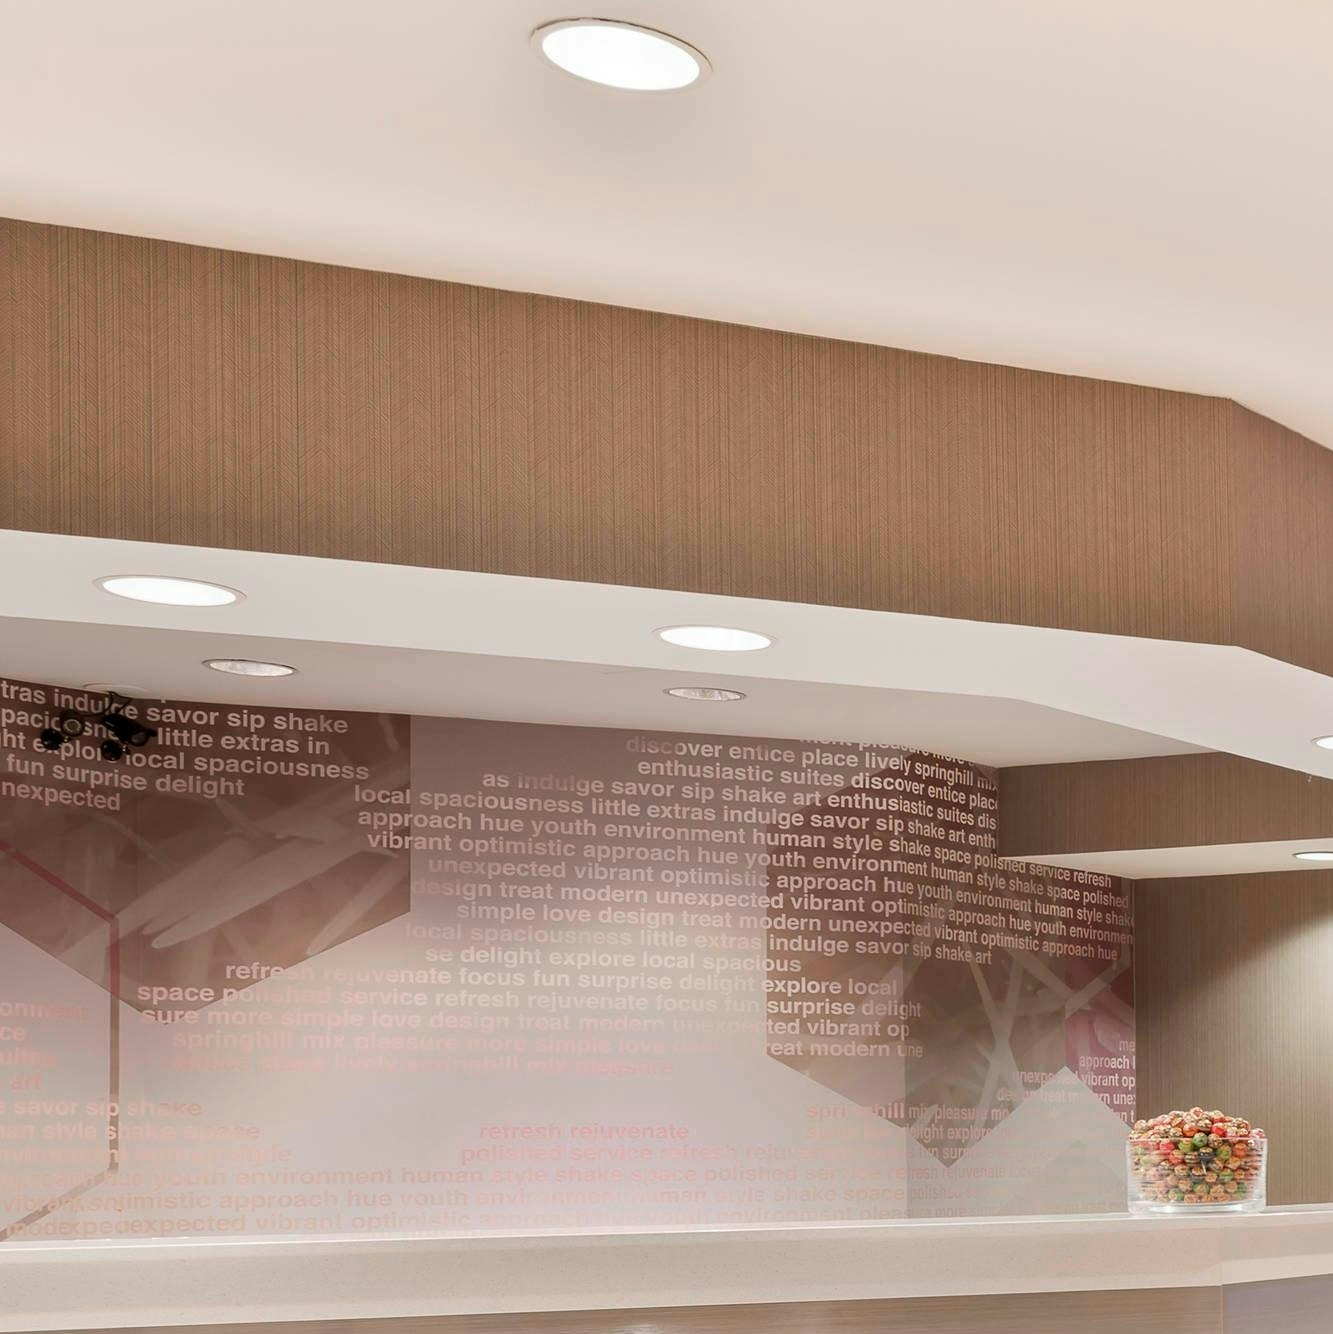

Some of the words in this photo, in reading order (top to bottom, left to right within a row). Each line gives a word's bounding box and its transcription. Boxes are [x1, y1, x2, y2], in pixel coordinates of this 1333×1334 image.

[146, 706, 218, 723] savor
[227, 708, 264, 731] sip
[273, 711, 348, 732] shake
[157, 724, 212, 747] little
[220, 734, 299, 752] extras
[308, 737, 329, 754] in
[6, 756, 44, 776] fun
[52, 766, 147, 789] surprise
[155, 773, 245, 798] delight
[126, 746, 184, 768] local
[194, 756, 368, 780] spaciousness
[626, 735, 721, 757] discover
[729, 744, 794, 762] entice
[801, 747, 858, 768] place
[865, 751, 910, 777] lively
[914, 761, 973, 785] springhill
[637, 759, 773, 782] enthusiastic
[780, 767, 844, 786] suites
[852, 770, 924, 794] discover
[928, 783, 965, 803] entice
[482, 774, 509, 788] as
[518, 772, 604, 797] indulge
[611, 781, 673, 796] savor
[680, 781, 713, 803] sip
[721, 783, 786, 803] shake
[792, 789, 820, 805] art
[827, 790, 933, 817] enthusiastic
[936, 804, 974, 825] suites
[354, 784, 409, 804] local
[420, 791, 583, 813] spaciousness
[591, 796, 640, 816] little
[646, 802, 715, 820] extras
[723, 804, 804, 828] indulge
[810, 813, 868, 830] savor
[875, 815, 903, 838] sip
[908, 818, 945, 839] shake
[948, 826, 965, 842] art
[968, 830, 995, 848] enth
[358, 812, 471, 831] approach
[480, 813, 523, 832] hue
[530, 817, 596, 837] youth
[603, 821, 745, 842] environment
[752, 825, 825, 847] human
[832, 832, 882, 854] style
[888, 834, 931, 855] shake
[934, 843, 971, 862] space
[1029, 861, 1071, 880] service
[1073, 866, 1111, 887] refresh
[367, 832, 451, 851] vibrant
[459, 836, 576, 857] optimistic
[583, 843, 690, 862] approach
[697, 844, 738, 863] hue
[745, 849, 805, 868] youth
[812, 853, 927, 876] environment
[931, 861, 972, 884] human
[976, 870, 1005, 892] style
[1009, 874, 1043, 894] shake
[1047, 883, 1080, 901] space
[1083, 886, 1128, 908] polished
[429, 861, 566, 881] unexpected
[574, 863, 653, 882] vibrant
[660, 867, 770, 888] optimistic
[776, 874, 876, 893] approach
[883, 875, 913, 894] hue
[917, 882, 952, 900] youth
[956, 886, 1030, 910] environment
[1035, 894, 1073, 917] human
[1076, 904, 1102, 925] style
[500, 882, 552, 900] treat
[560, 884, 648, 903] modern
[655, 891, 783, 910] unexpected
[790, 892, 864, 911] vibrant
[871, 896, 945, 919] optimistic
[948, 907, 1006, 927] approach
[1009, 911, 1031, 930] hue
[1034, 918, 1066, 936] youth
[456, 904, 535, 926] simple
[543, 905, 591, 924] love
[598, 907, 673, 930] design
[681, 910, 731, 927] treat
[739, 911, 820, 930] modern
[830, 918, 930, 937] unexpected
[934, 922, 977, 943] vibrant
[981, 930, 1039, 952] optimistic
[1042, 940, 1094, 959] approach
[1097, 942, 1117, 961] hue
[470, 927, 632, 948] spaciousness
[639, 929, 688, 947] little
[693, 933, 760, 950] extras
[769, 934, 848, 957] indulge
[855, 941, 909, 955] savor
[912, 940, 930, 962] sip
[934, 942, 971, 962] shake
[975, 949, 992, 965] art
[460, 944, 541, 967] delight
[550, 948, 635, 969] explore
[643, 949, 693, 968] local
[702, 953, 801, 973] spacious
[459, 967, 524, 985] focus
[533, 968, 569, 986] fun
[579, 971, 671, 992] surprise
[679, 972, 757, 994] delight
[762, 975, 841, 996] explore
[849, 976, 897, 995] local
[137, 987, 214, 1004] space
[340, 987, 427, 1005] service
[435, 988, 519, 1006] refresh
[529, 990, 649, 1012] rejuvenate
[656, 992, 717, 1010] focus
[724, 993, 758, 1011] fun
[767, 996, 855, 1017] surprise
[861, 997, 921, 1020] delight
[209, 1011, 271, 1025] more
[280, 1008, 361, 1030] simple
[373, 1009, 420, 1027] love
[431, 1010, 509, 1033] design
[518, 1013, 568, 1030] treat
[807, 1018, 881, 1036] vibrant
[810, 1038, 890, 1056] modern
[1079, 1054, 1129, 1070] approach
[1081, 1072, 1119, 1087] vibrant
[479, 1124, 561, 1140] refresh
[570, 1124, 689, 1142] rejuvenate
[235, 1167, 392, 1185] environment
[401, 1167, 482, 1184] human
